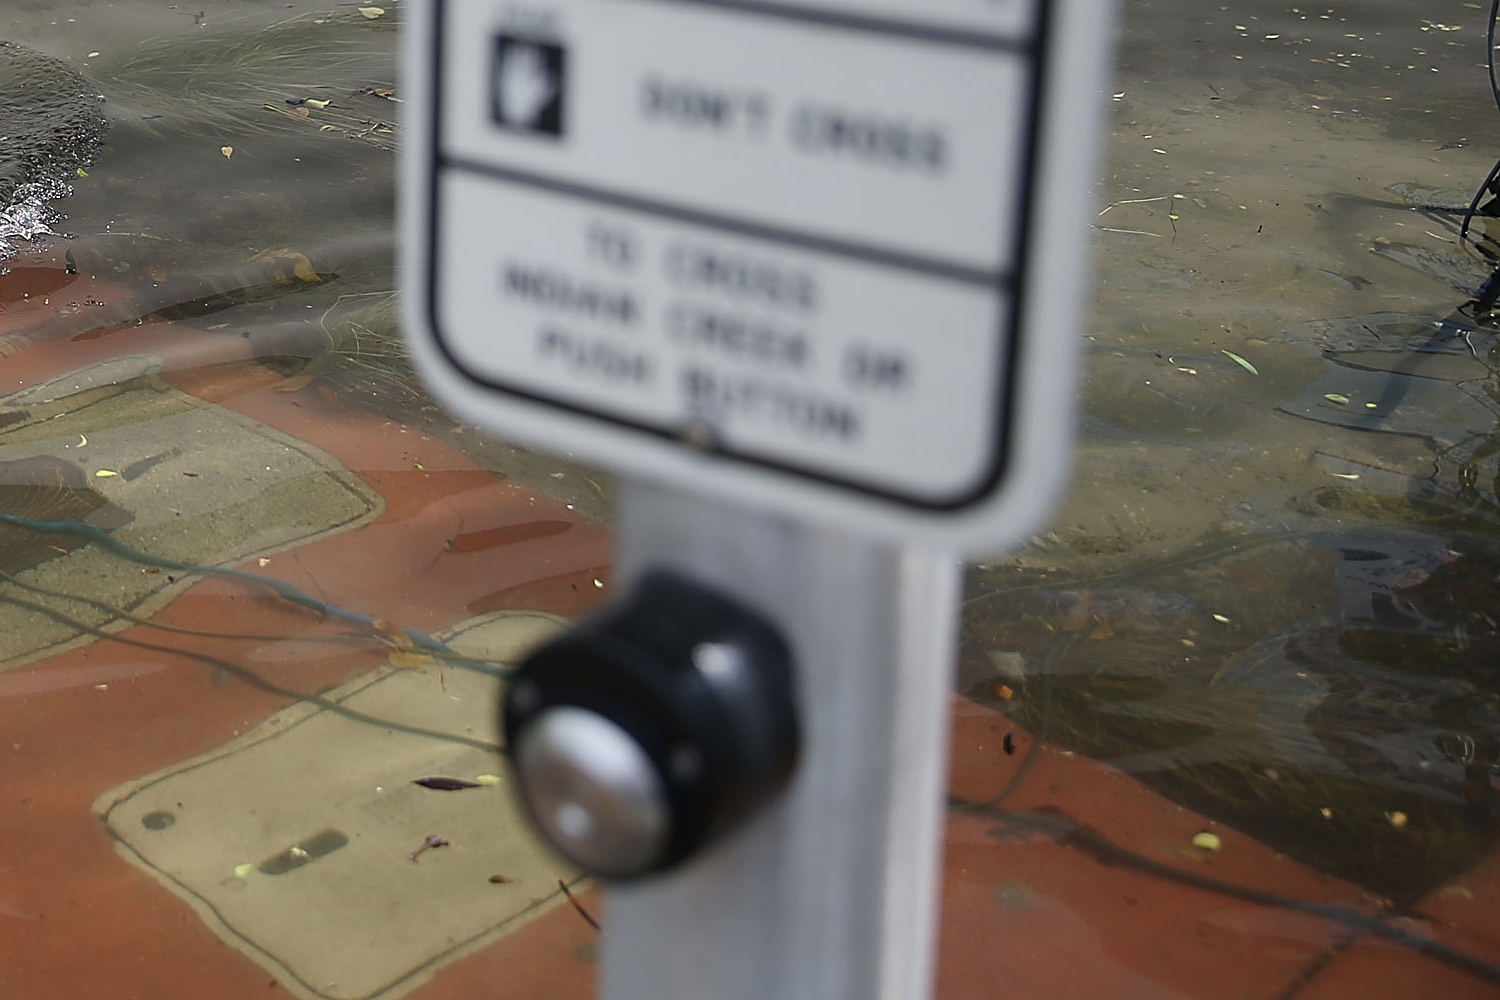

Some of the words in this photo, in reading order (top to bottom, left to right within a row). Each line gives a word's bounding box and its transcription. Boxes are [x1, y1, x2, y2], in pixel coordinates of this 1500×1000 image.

[639, 73, 772, 145] DON'T
[787, 100, 950, 178] CROSS
[585, 221, 639, 273] TO
[664, 243, 822, 316] CROSS
[539, 324, 652, 381] PUSH
[682, 366, 865, 442] BUTTON
[665, 301, 812, 370] CREEK
